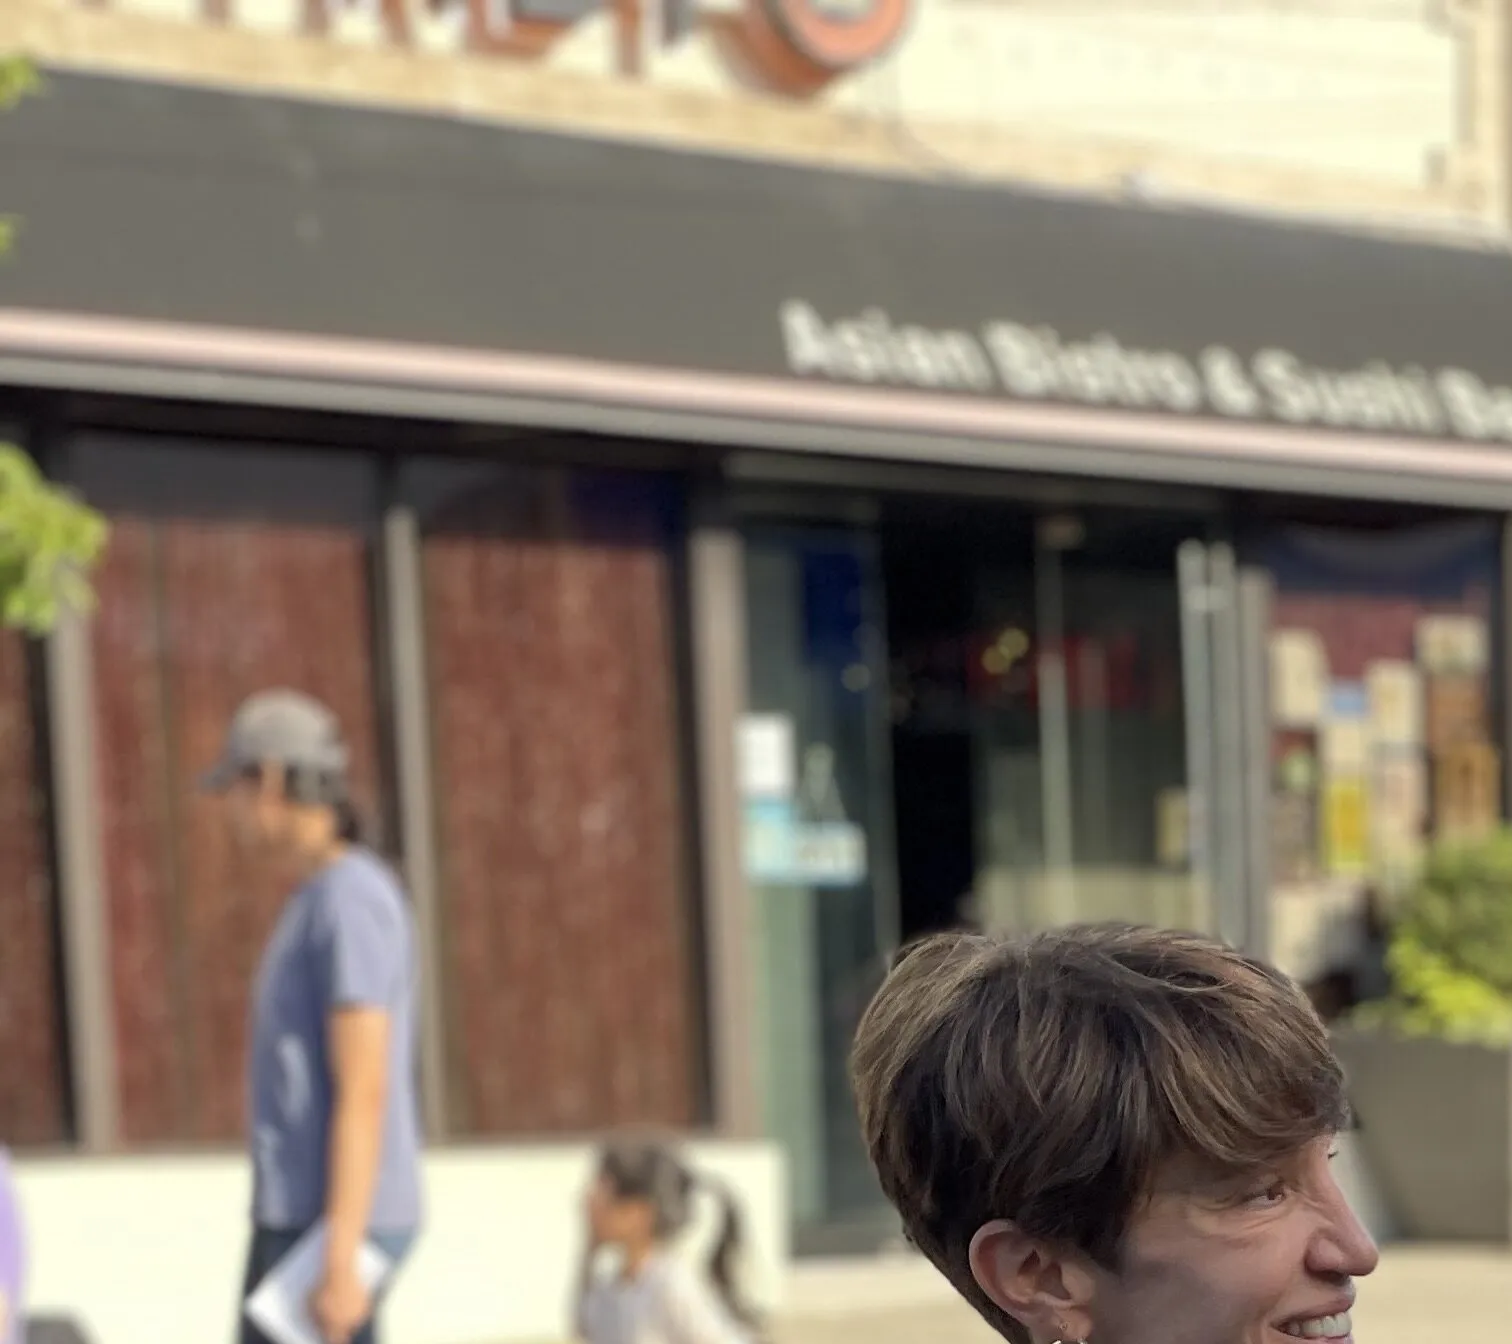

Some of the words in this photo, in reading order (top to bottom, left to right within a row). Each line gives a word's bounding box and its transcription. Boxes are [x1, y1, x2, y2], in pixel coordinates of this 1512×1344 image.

[779, 298, 993, 391] Asian
[984, 316, 1198, 412] Bistro
[1201, 342, 1258, 417] &
[1250, 344, 1444, 433] Sushi
